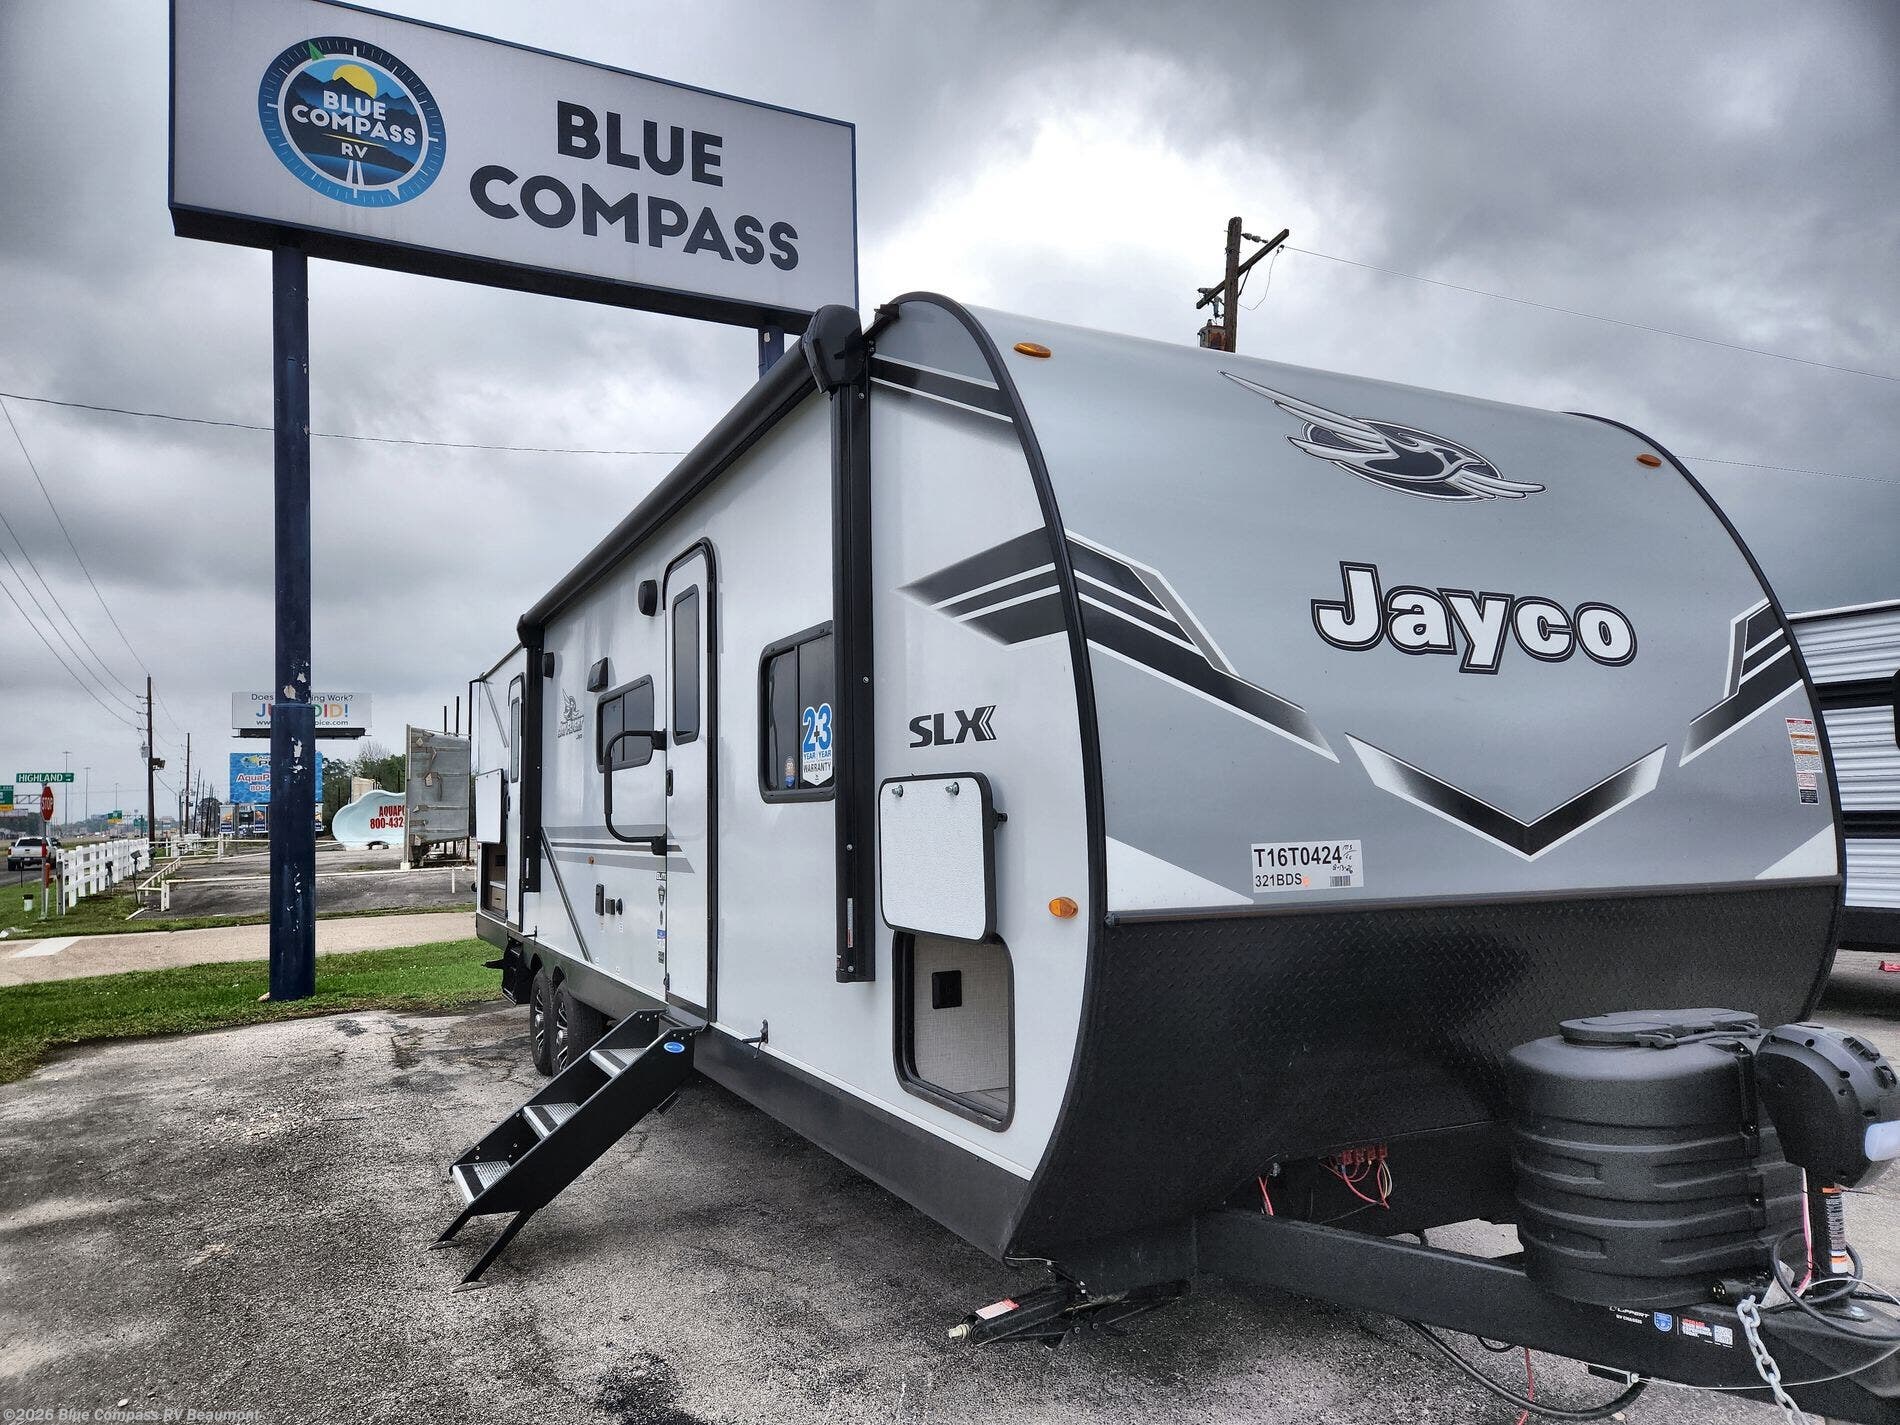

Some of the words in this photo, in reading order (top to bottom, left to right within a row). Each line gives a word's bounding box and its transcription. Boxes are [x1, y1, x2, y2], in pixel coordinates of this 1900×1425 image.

[324, 90, 386, 121] BLUE
[291, 104, 416, 146] COMPASS
[341, 142, 368, 158] RV
[557, 100, 723, 187] BLUE
[469, 164, 799, 271] COMPASS
[1311, 561, 1637, 675] Jayco
[251, 693, 274, 701] Does
[327, 694, 354, 702] Work?
[908, 705, 997, 749] SLX
[803, 752, 816, 760] YEAR
[818, 750, 832, 758] YEAR
[803, 762, 831, 773] WARRANTY
[18, 773, 63, 782] HIGHLAND
[41, 796, 53, 811] STOP
[1253, 845, 1342, 867] T16T0424
[1255, 873, 1302, 887] 321BDS
